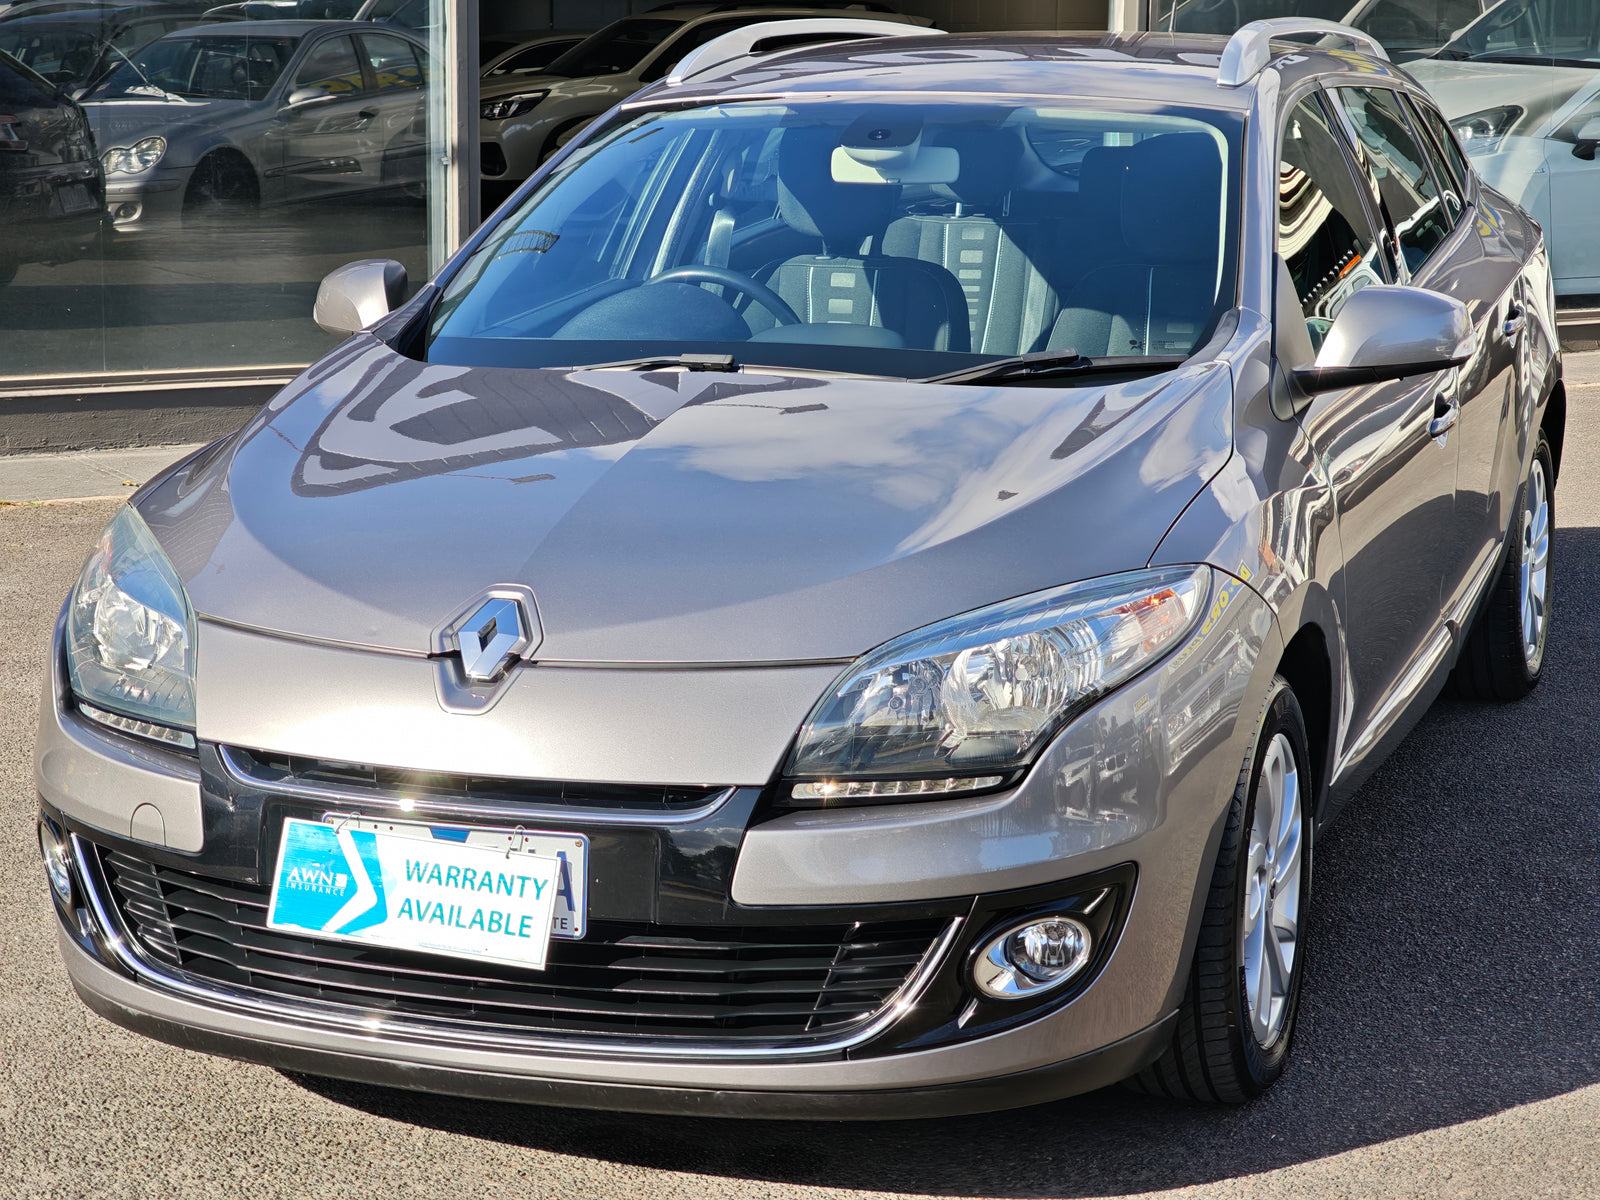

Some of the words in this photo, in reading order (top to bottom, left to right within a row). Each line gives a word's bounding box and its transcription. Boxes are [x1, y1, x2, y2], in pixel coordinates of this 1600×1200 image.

[286, 880, 345, 897] INSURANCE
[287, 866, 334, 886] AWN
[406, 859, 549, 900] WARRANTY
[397, 898, 533, 938] AVAILABLE
